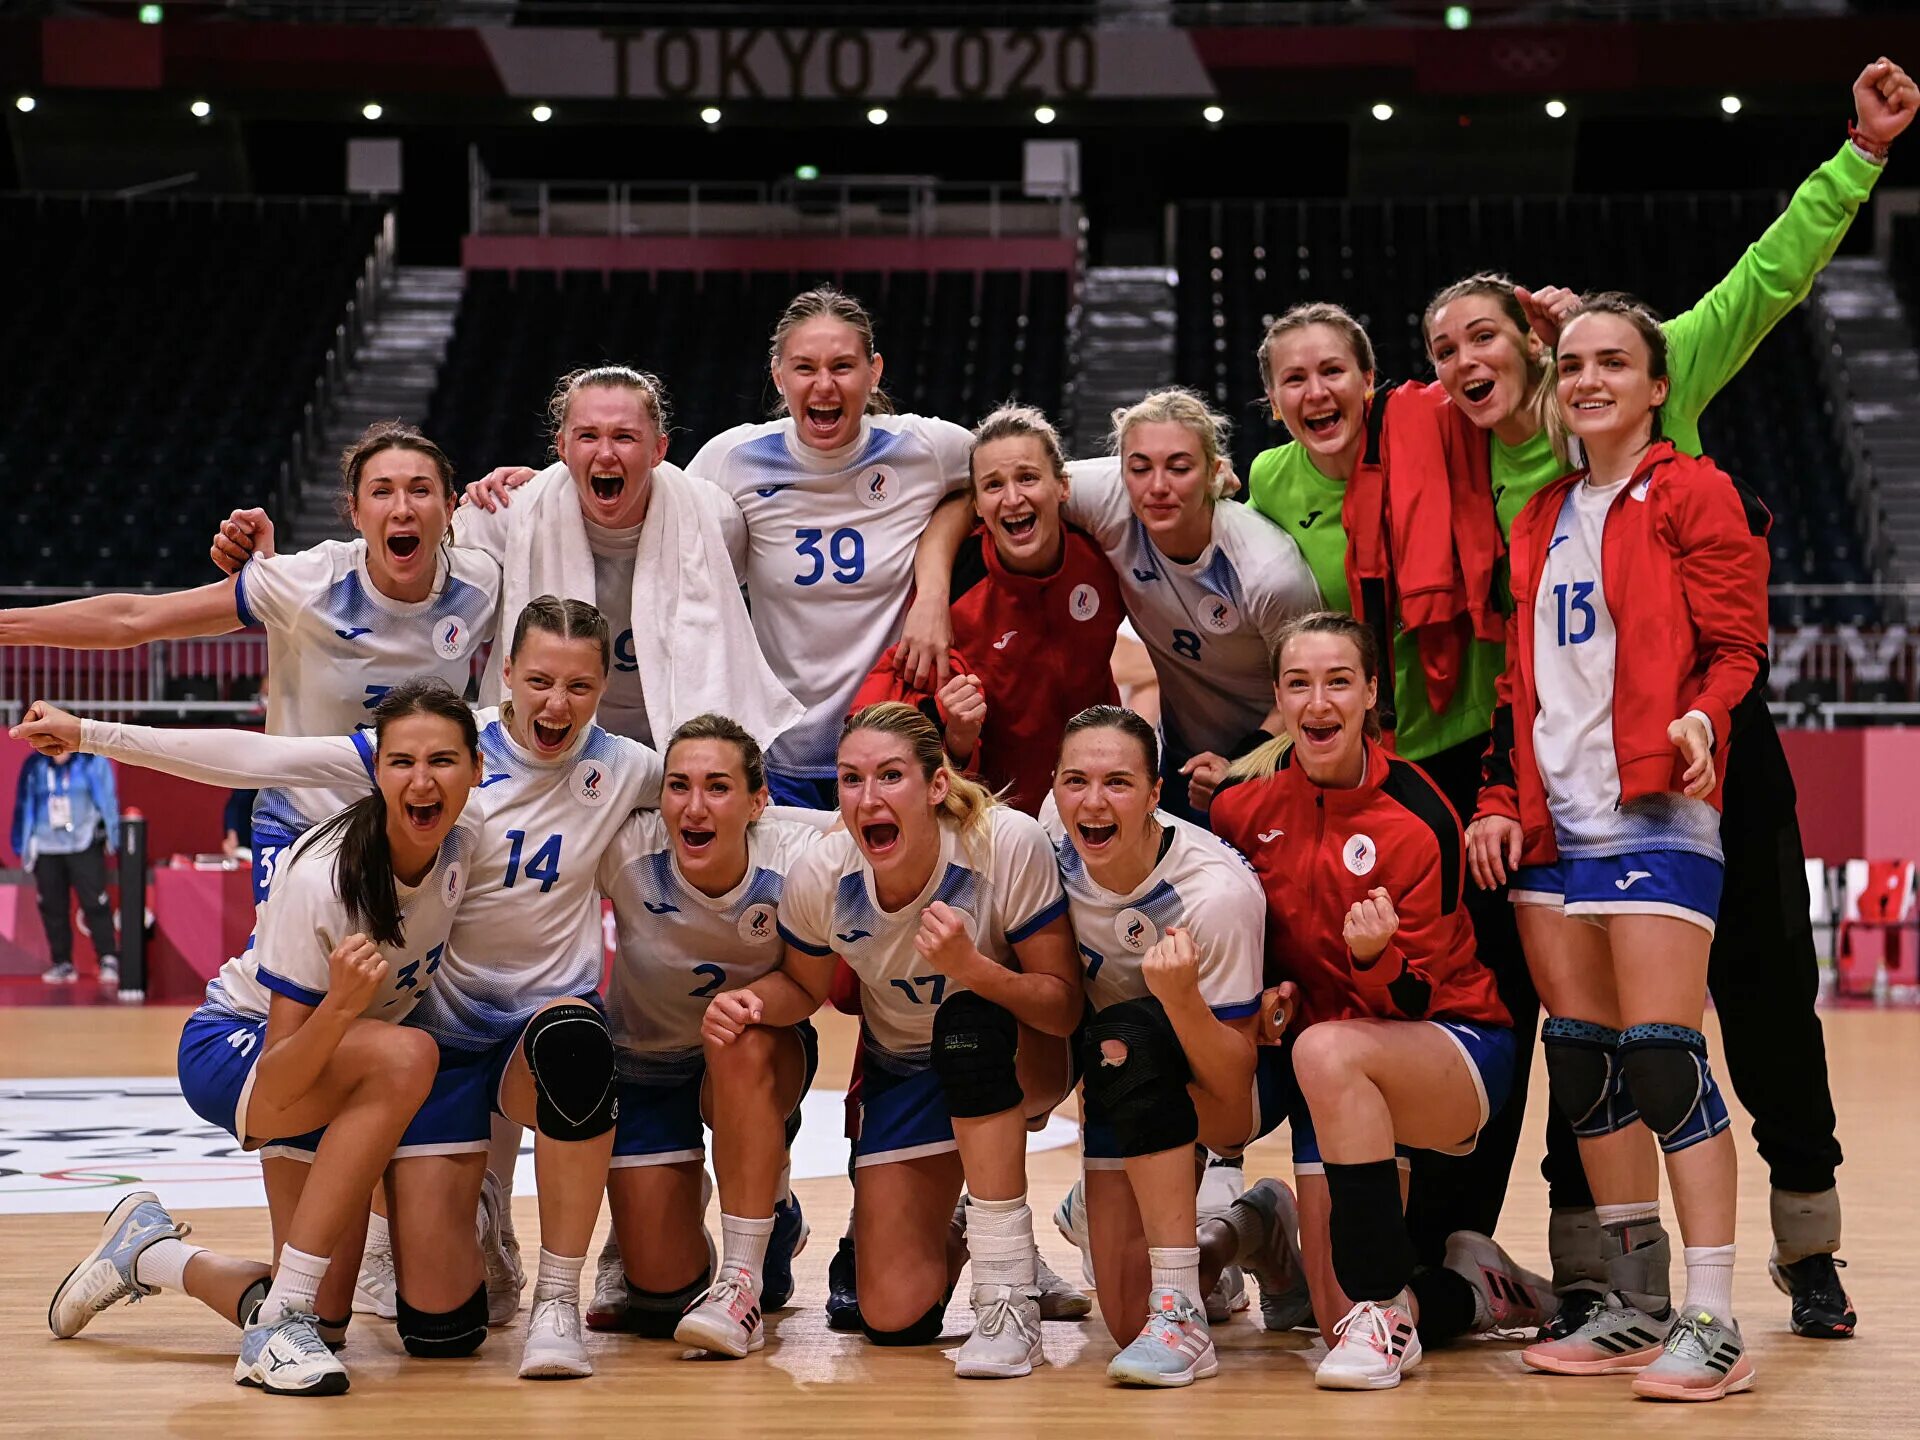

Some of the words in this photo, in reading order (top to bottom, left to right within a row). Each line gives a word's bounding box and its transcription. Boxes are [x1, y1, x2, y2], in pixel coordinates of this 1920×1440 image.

[601, 31, 871, 98] TOKYO
[900, 31, 1094, 98] 2020
[794, 527, 865, 586] 39
[1553, 581, 1596, 646] 13
[1172, 629, 1202, 661] 8
[503, 829, 563, 892] 14
[688, 963, 726, 998] 2
[890, 974, 947, 1005] 17
